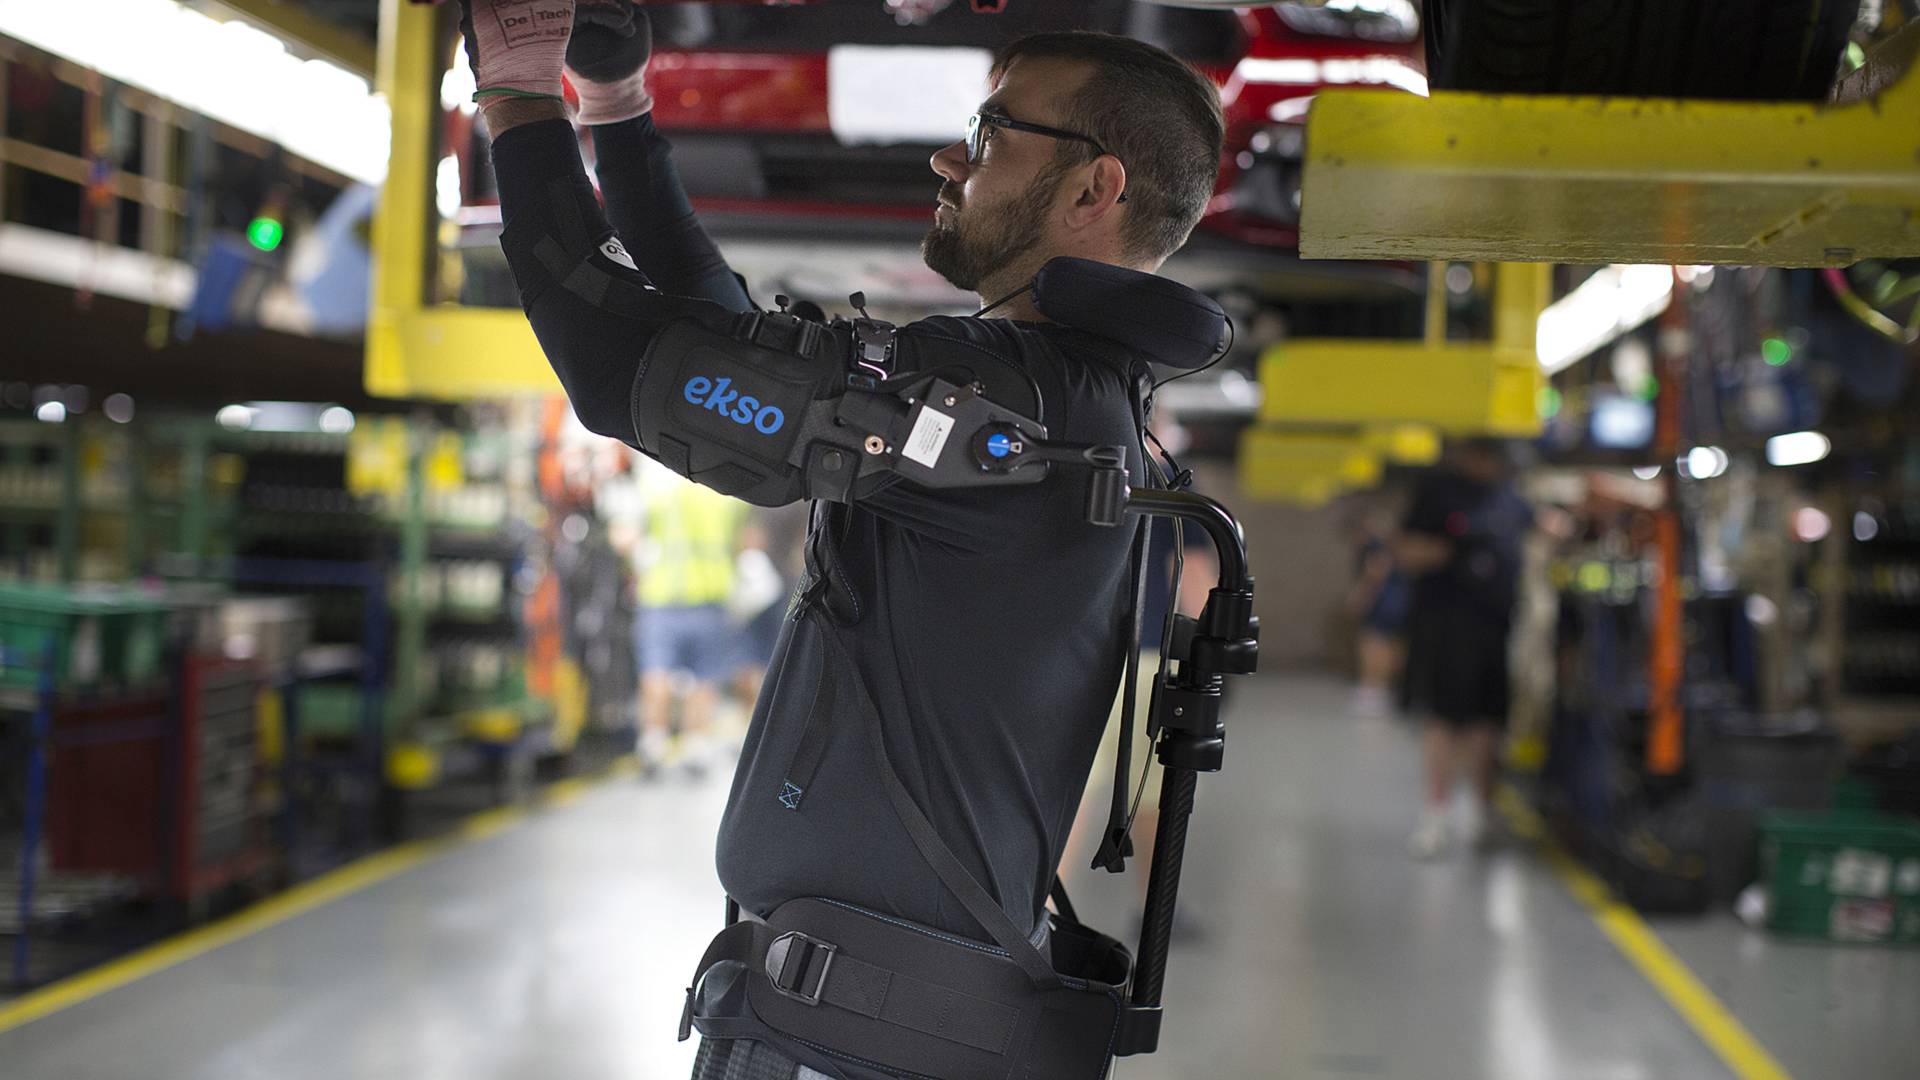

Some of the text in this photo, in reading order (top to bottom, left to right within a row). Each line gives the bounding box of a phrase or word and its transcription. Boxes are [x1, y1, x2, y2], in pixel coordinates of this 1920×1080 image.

[504, 7, 571, 28] De Tach
[684, 376, 784, 435] ekso
